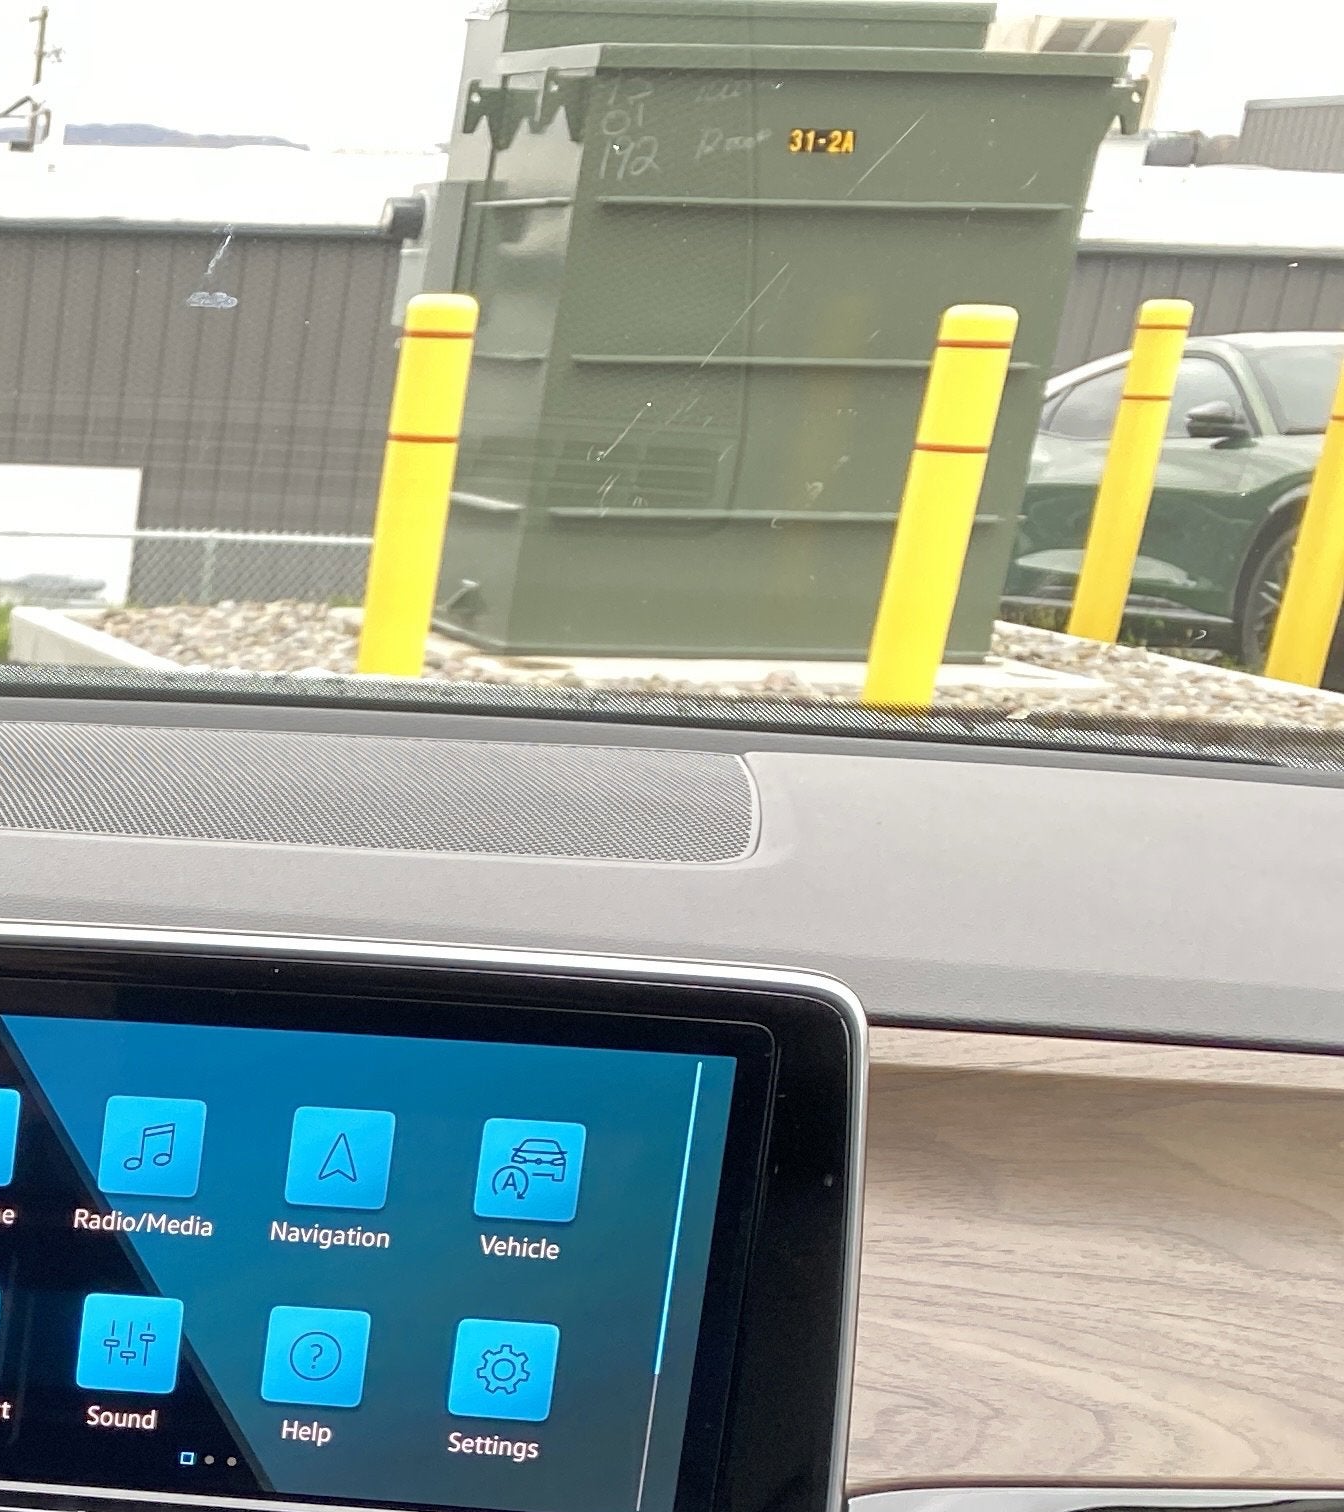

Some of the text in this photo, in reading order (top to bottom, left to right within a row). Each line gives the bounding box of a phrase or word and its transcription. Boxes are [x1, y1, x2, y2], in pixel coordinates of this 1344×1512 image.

[787, 128, 856, 154] 31-2A
[73, 1209, 214, 1238] Radio/Media
[270, 1221, 391, 1251] Navigation
[480, 1235, 561, 1260] Vehicle
[87, 1406, 157, 1431] Sound
[281, 1420, 333, 1447] Help
[448, 1432, 539, 1460] Settings
